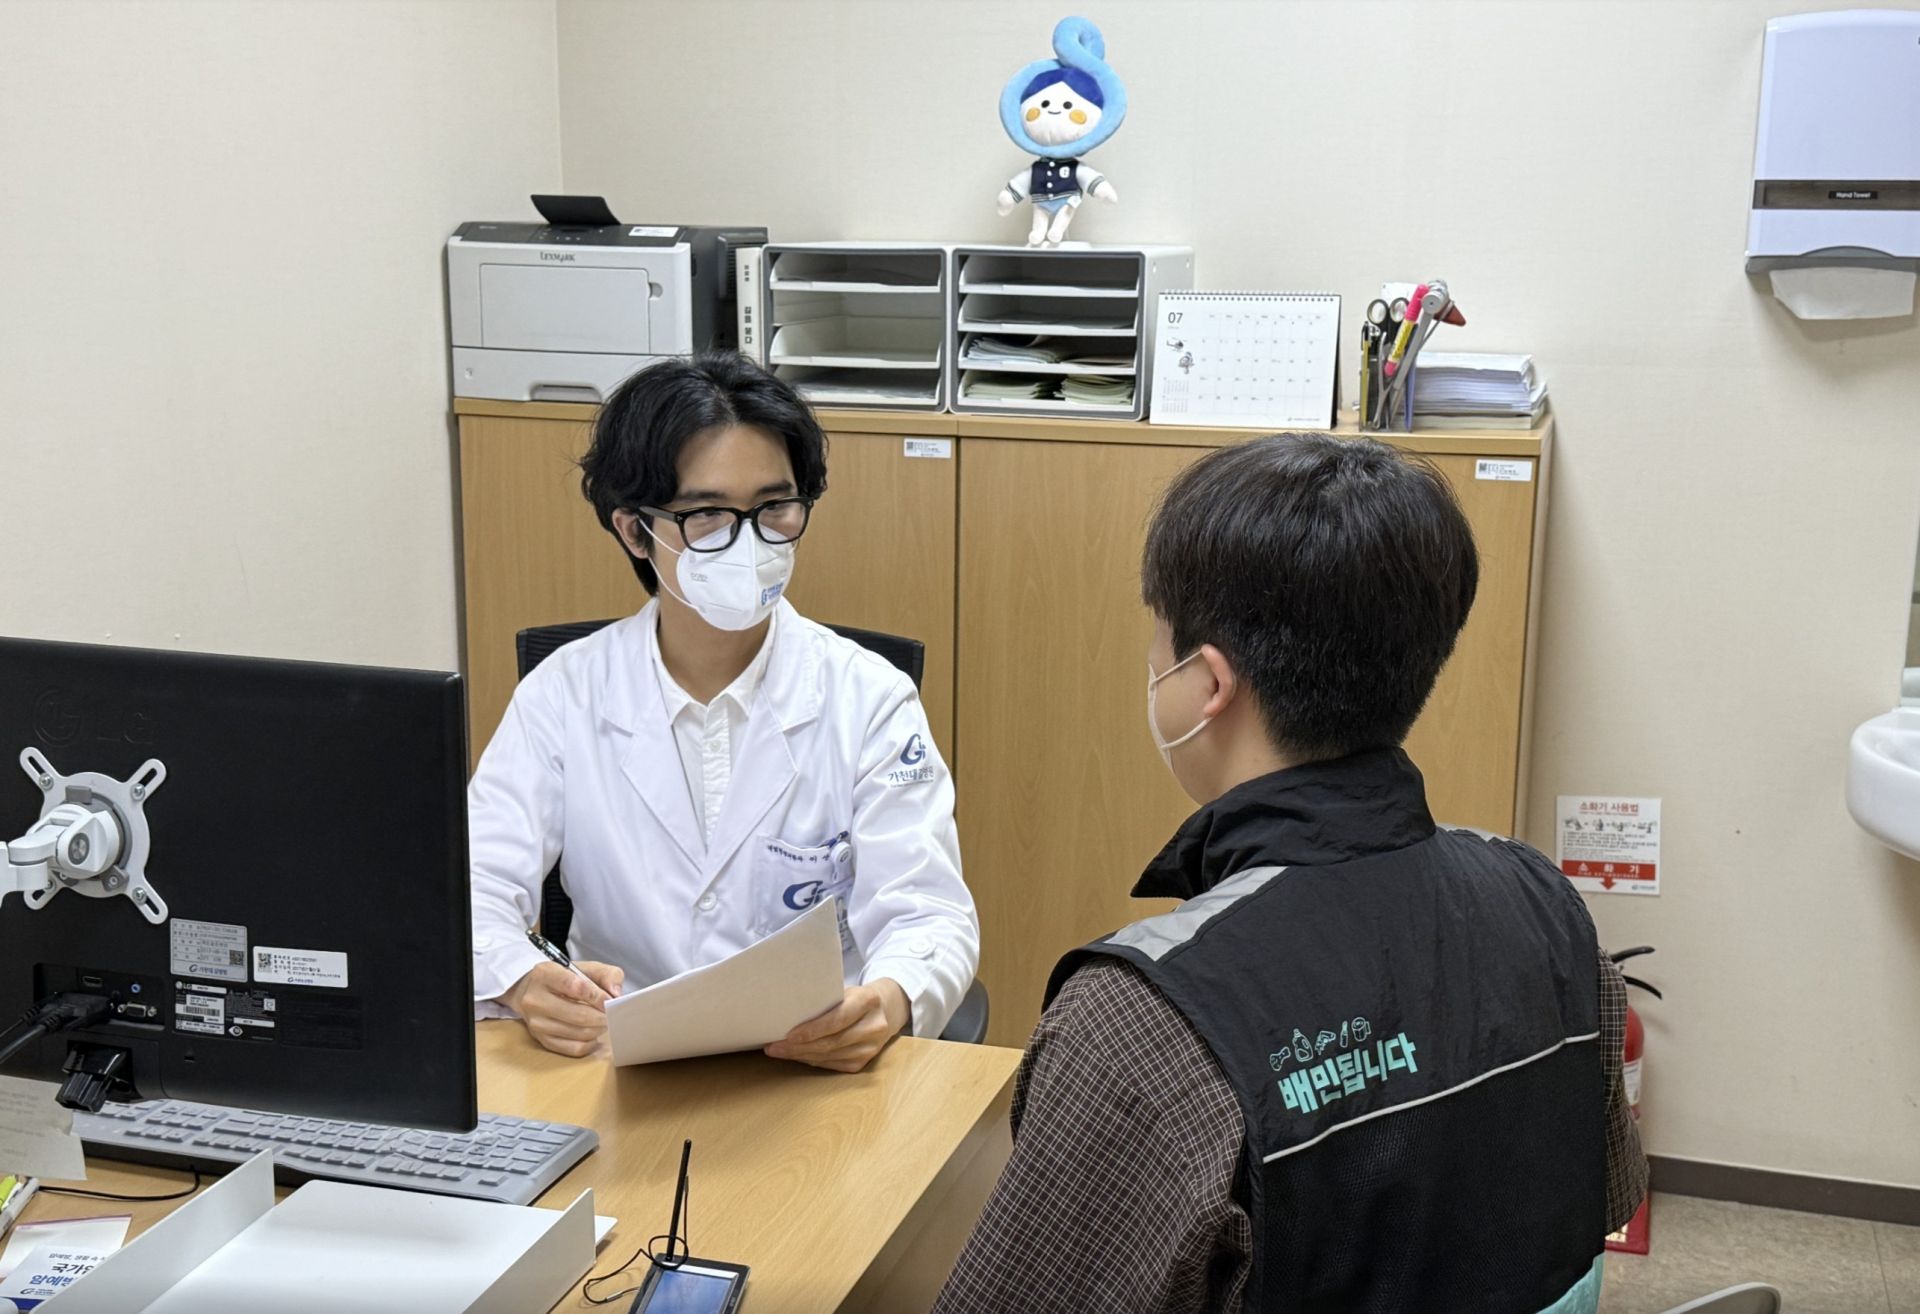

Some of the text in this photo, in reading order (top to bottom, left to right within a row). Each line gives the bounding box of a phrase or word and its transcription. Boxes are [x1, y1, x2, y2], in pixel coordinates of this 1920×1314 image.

[1836, 191, 1871, 199] Hand Towel
[1167, 311, 1183, 324] 07
[1579, 801, 1639, 813] 소화기 사용법
[1277, 1032, 1418, 1114] 배민됩니다
